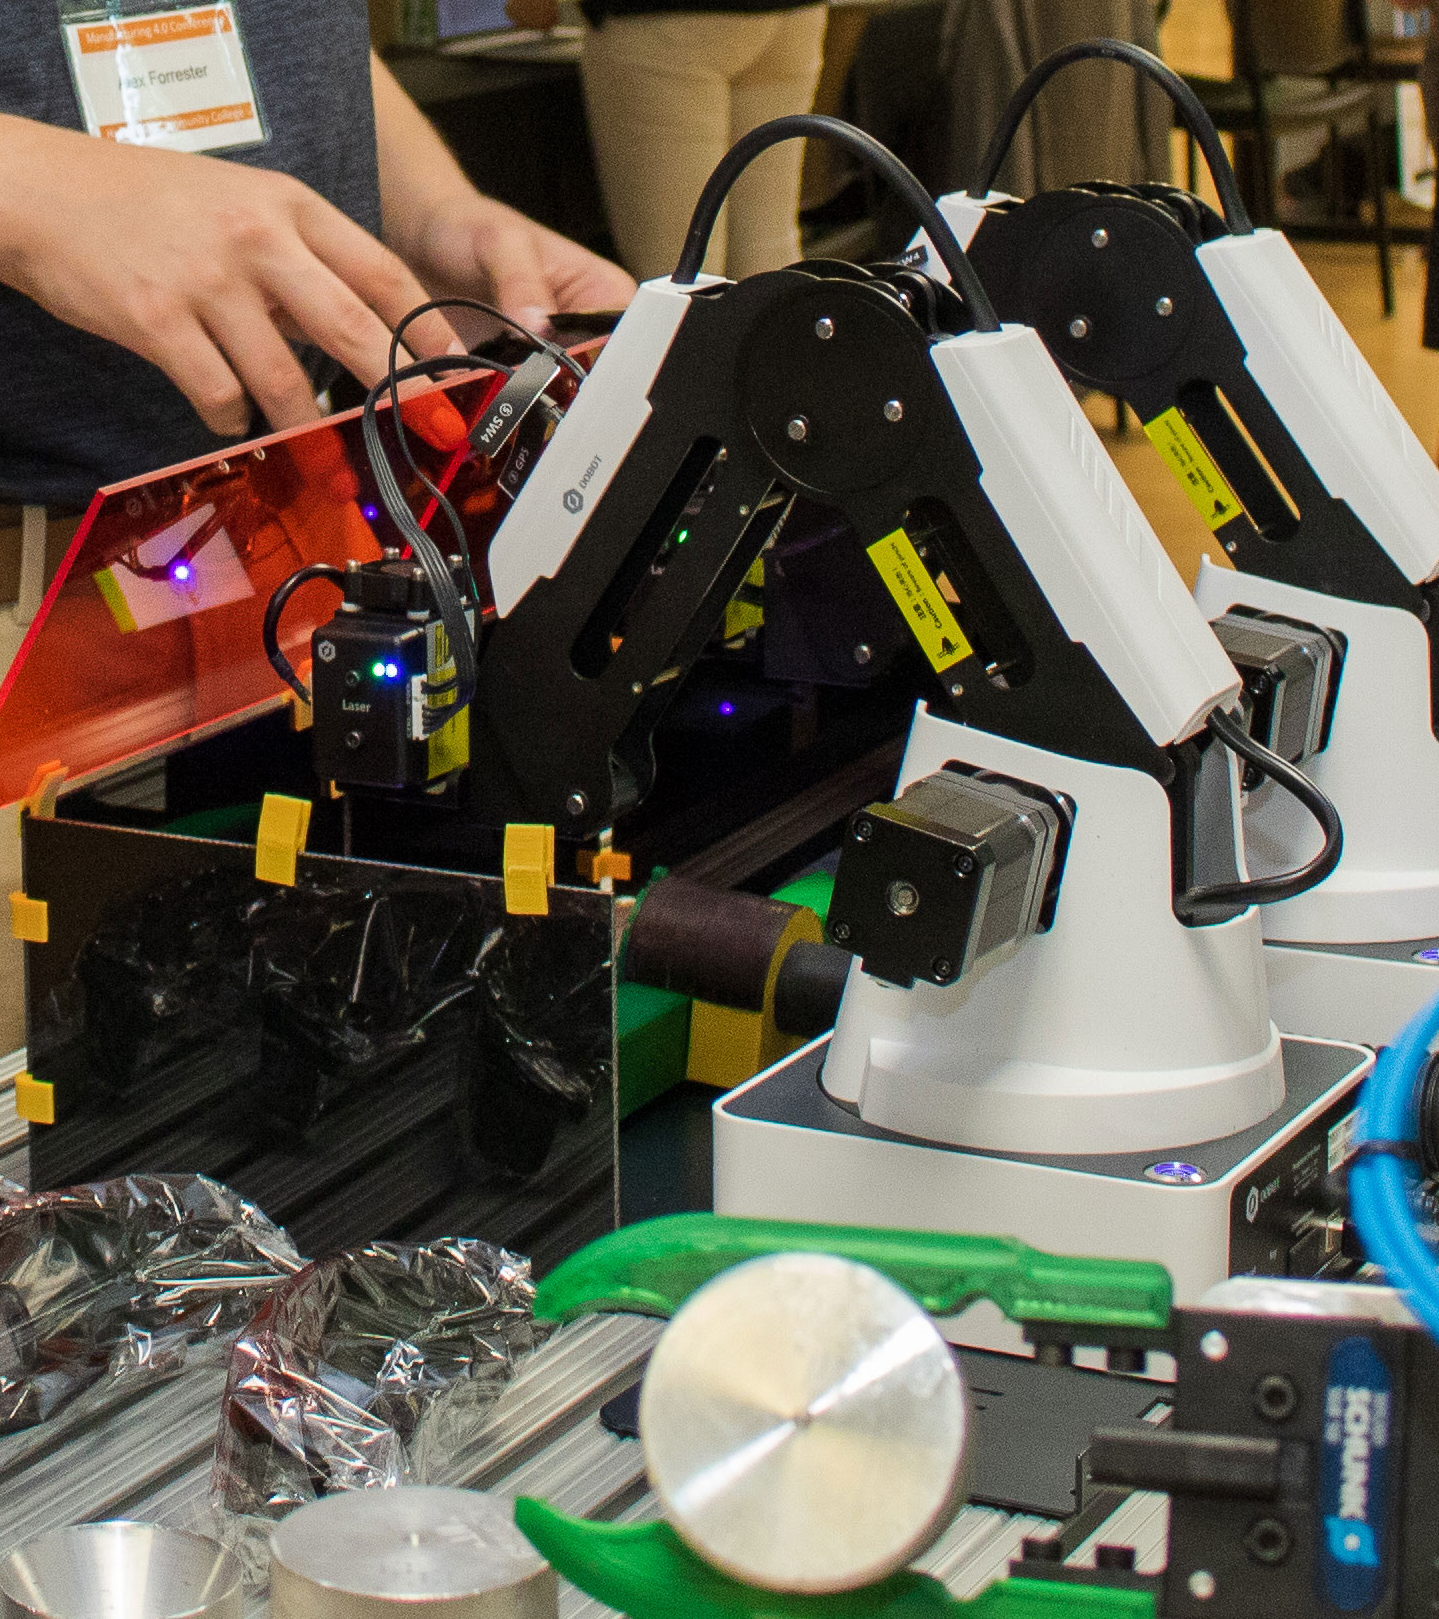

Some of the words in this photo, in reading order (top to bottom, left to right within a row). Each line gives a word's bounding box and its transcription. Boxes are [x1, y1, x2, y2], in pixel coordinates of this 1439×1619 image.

[148, 64, 209, 86] Forrester
[480, 415, 504, 443] SW4
[579, 454, 603, 490] DOBOT
[342, 699, 372, 713] Laser
